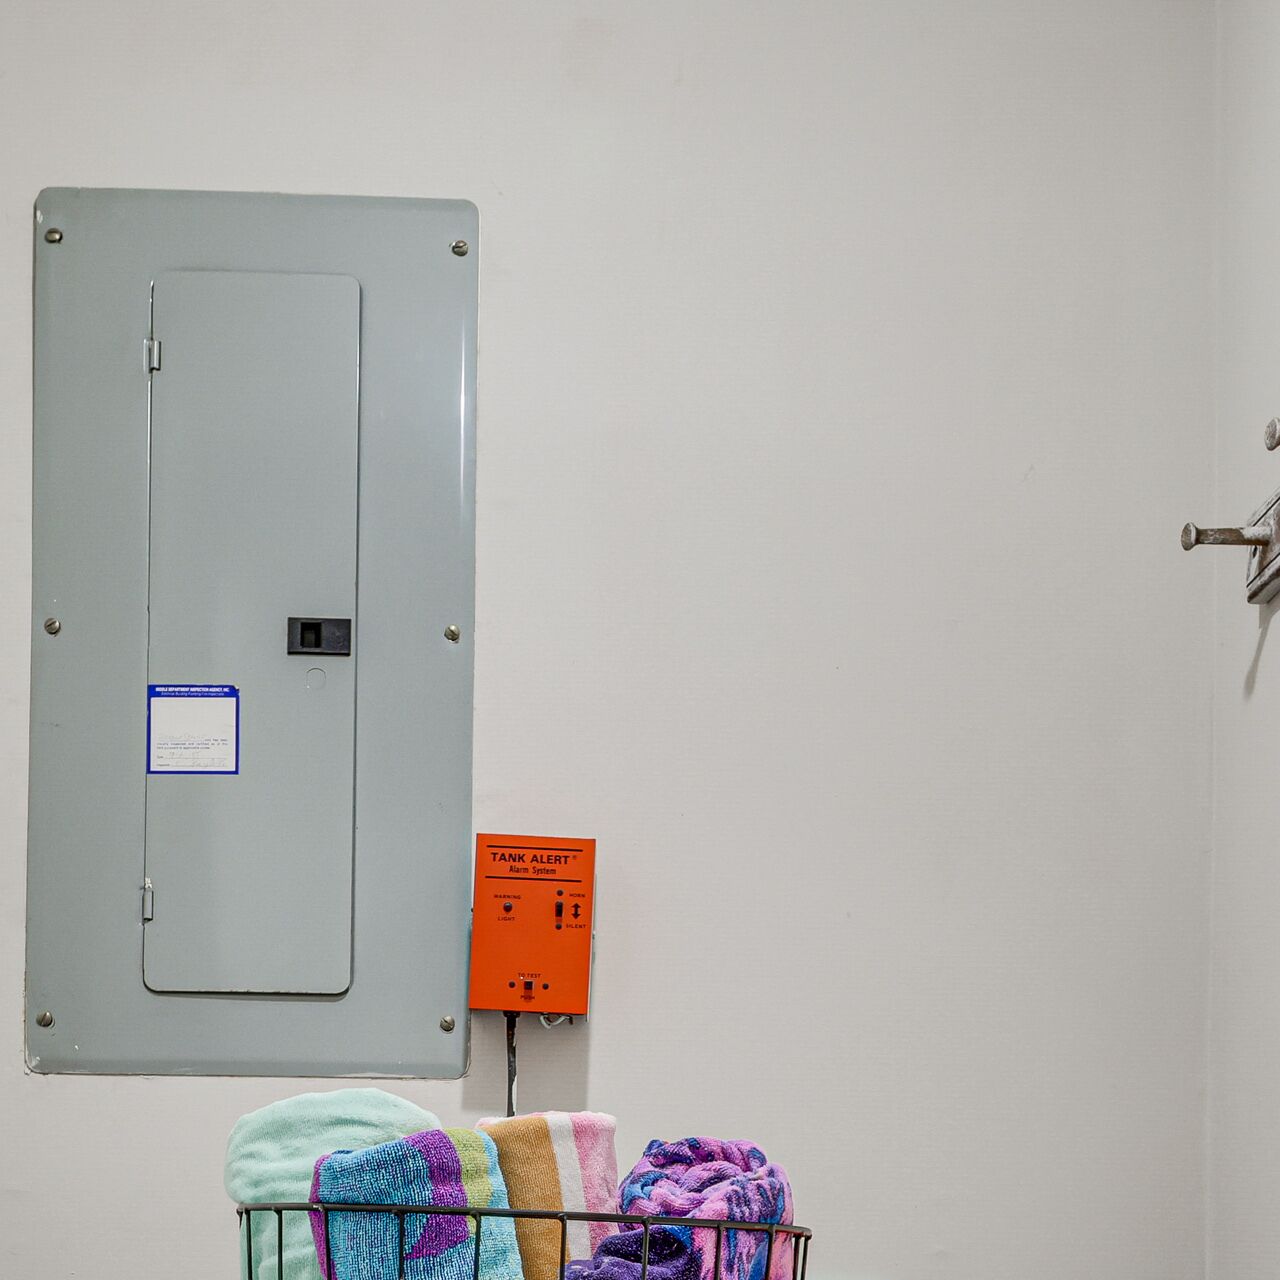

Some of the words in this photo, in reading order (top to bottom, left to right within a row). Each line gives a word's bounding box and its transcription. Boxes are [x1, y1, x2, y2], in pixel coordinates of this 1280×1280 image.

[491, 852, 526, 863] TANK
[530, 854, 570, 865] ALERT
[509, 866, 528, 874] Alarm
[532, 866, 556, 875] System
